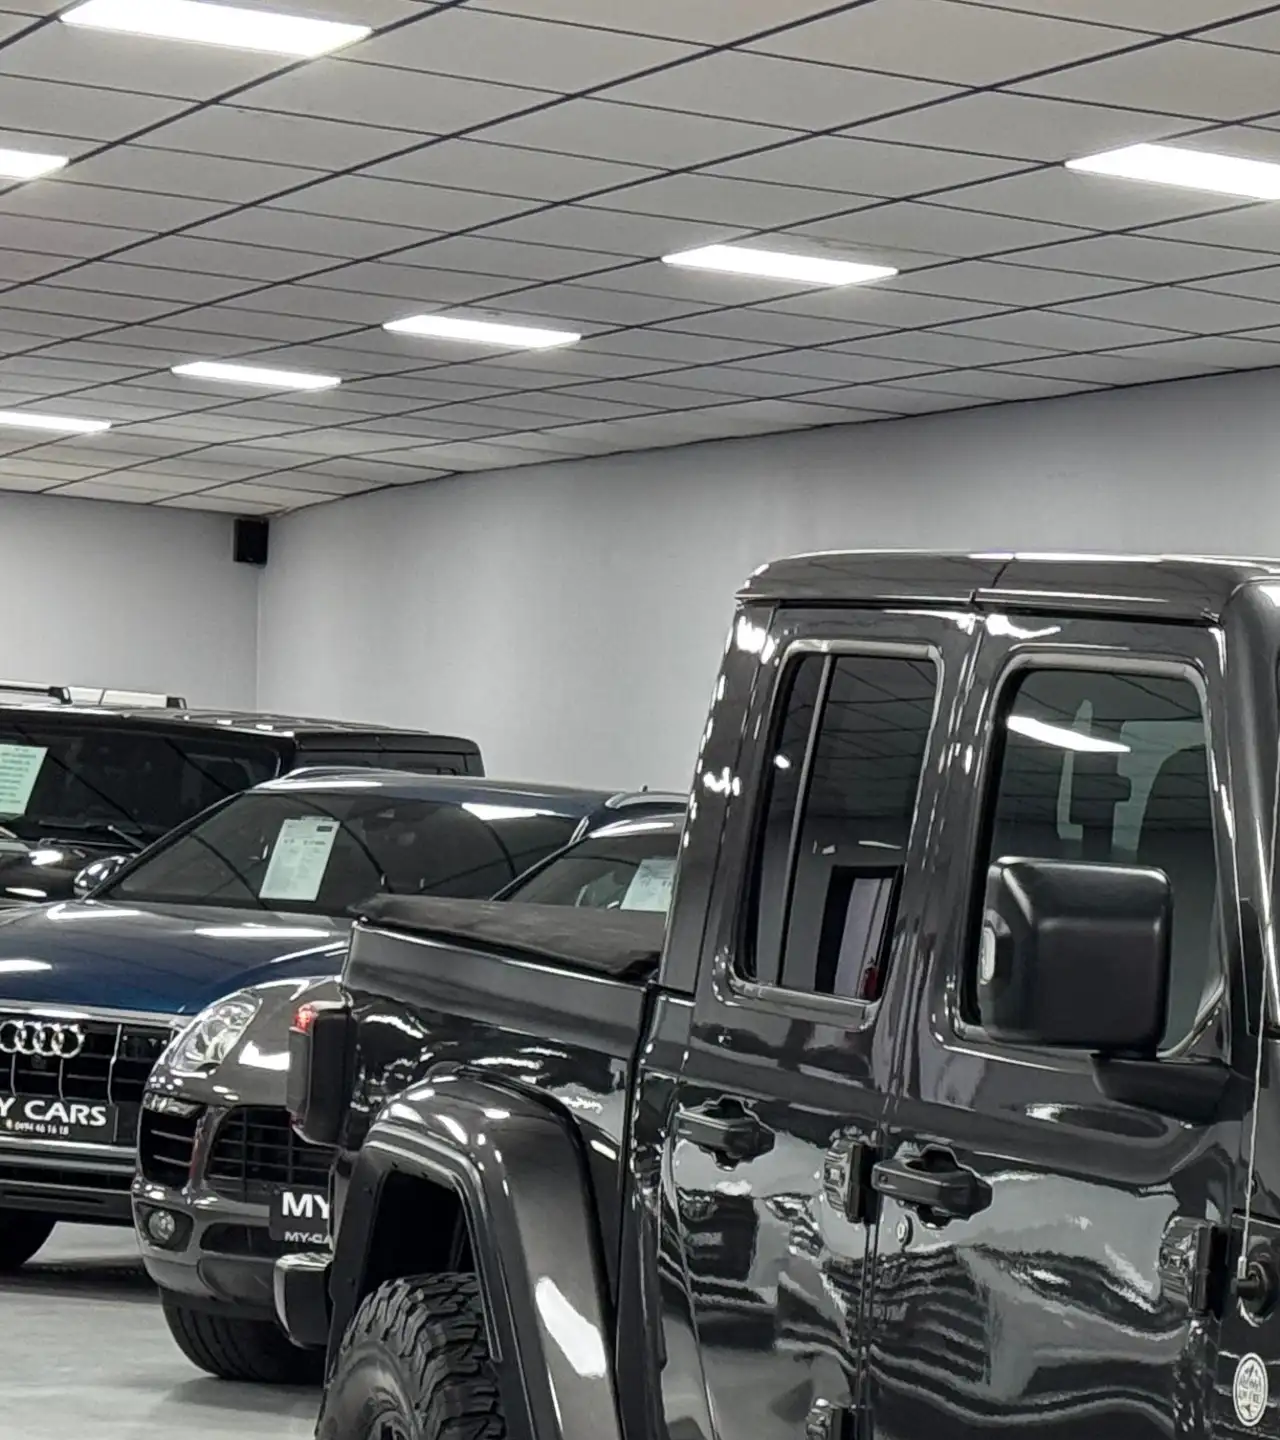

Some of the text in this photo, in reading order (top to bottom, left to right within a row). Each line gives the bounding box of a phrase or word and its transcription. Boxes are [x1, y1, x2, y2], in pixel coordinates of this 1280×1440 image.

[0, 1097, 107, 1126] Y CARS
[282, 1191, 329, 1219] MY
